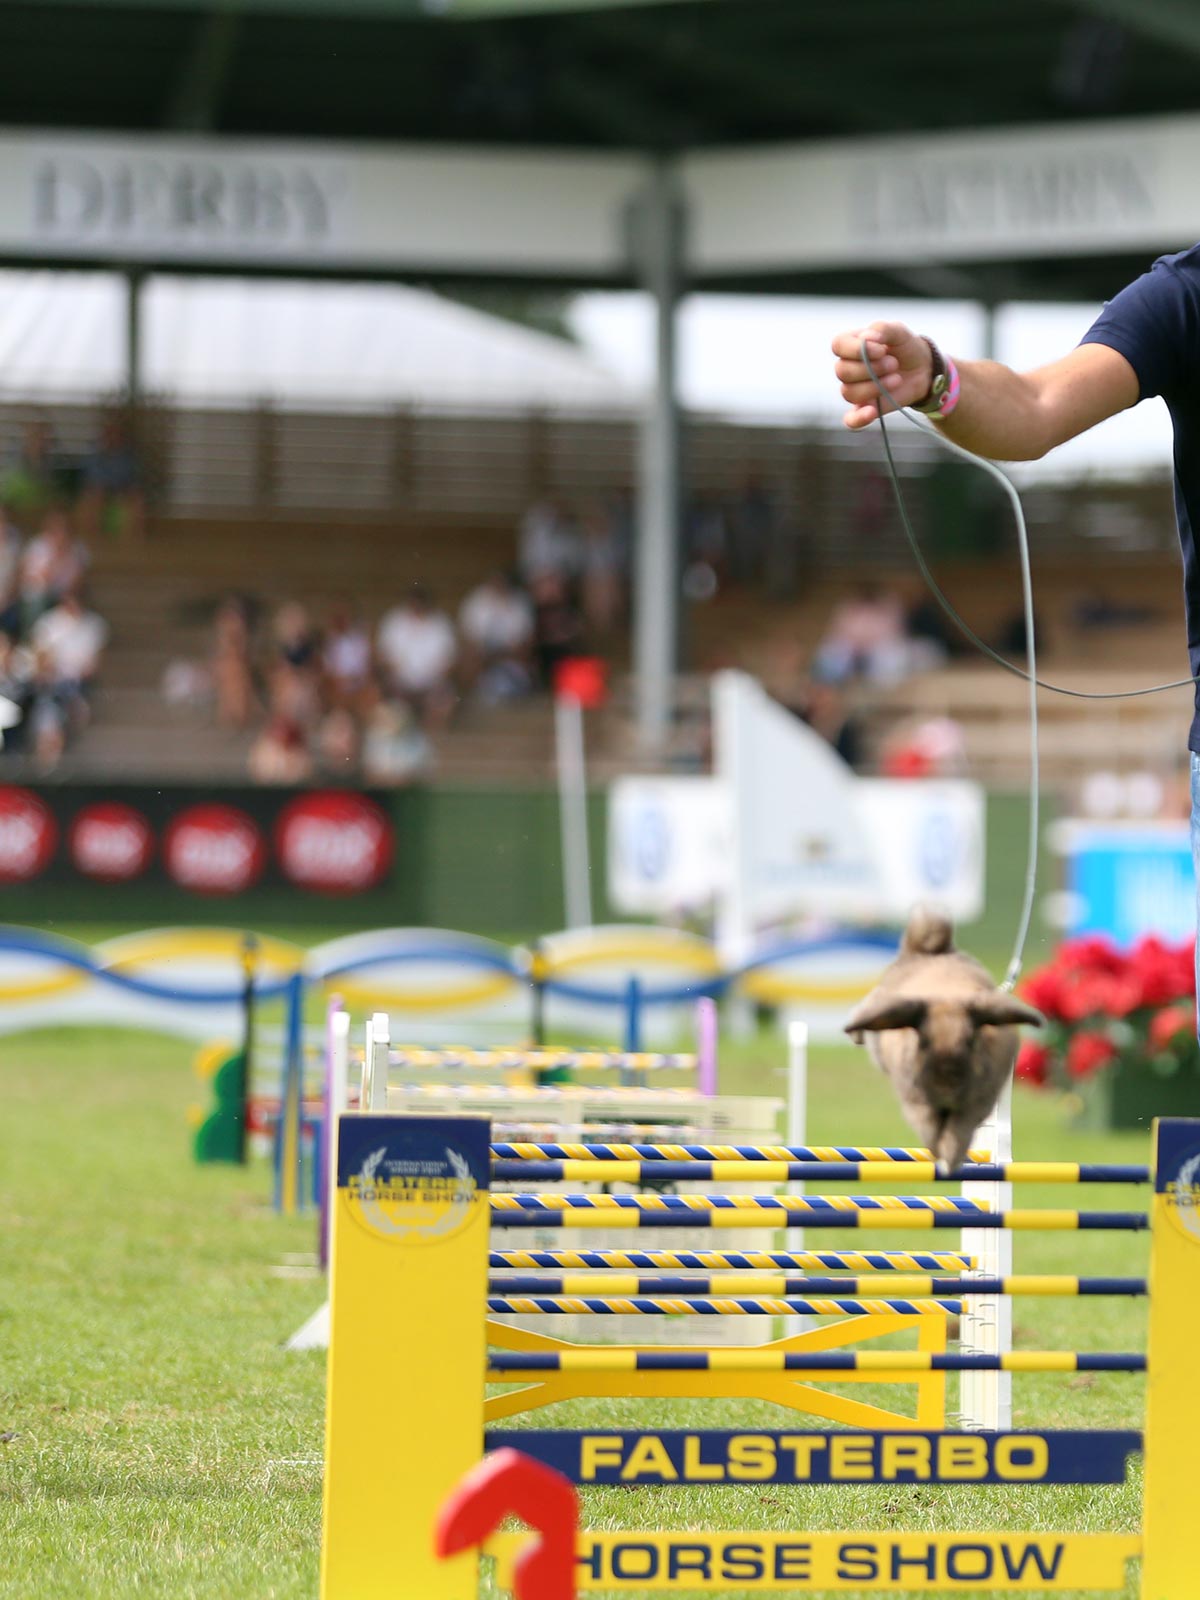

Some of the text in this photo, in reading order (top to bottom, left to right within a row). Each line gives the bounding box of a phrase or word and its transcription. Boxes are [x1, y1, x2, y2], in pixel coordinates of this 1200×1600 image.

[348, 1175, 478, 1190] FALSTERBO
[580, 1434, 1049, 1480] FALSTERBO
[836, 1542, 1065, 1581] SHOW
